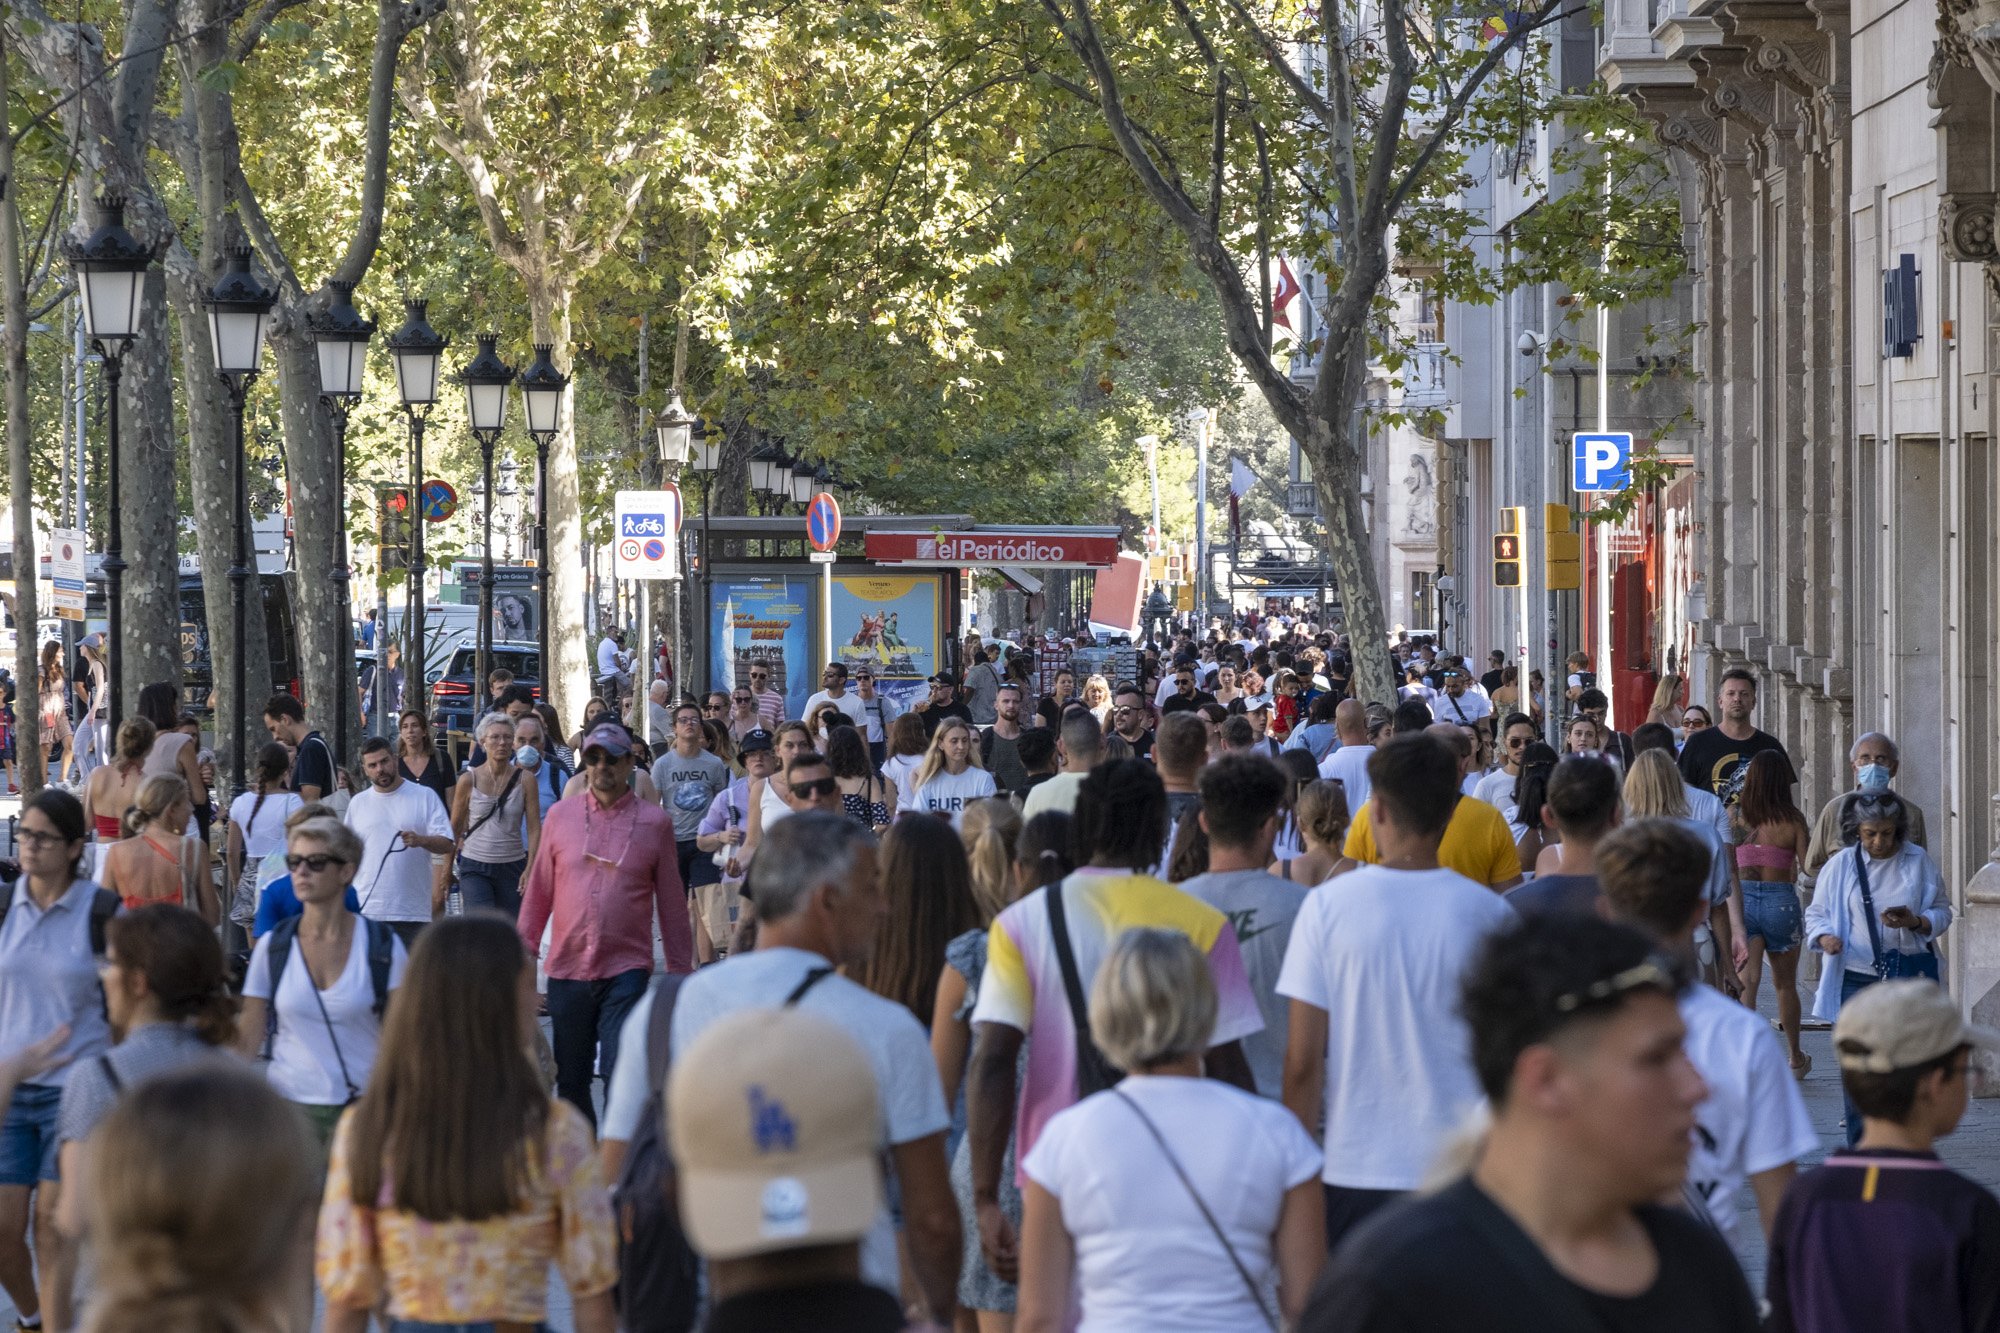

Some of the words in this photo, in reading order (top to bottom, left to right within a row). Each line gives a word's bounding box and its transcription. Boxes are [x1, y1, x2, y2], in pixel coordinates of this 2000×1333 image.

[1585, 441, 1620, 484] P
[624, 545, 637, 556] 10
[938, 539, 957, 559] el
[960, 539, 1064, 560] Periódico
[672, 771, 709, 782] NASA
[928, 797, 964, 812] BUR
